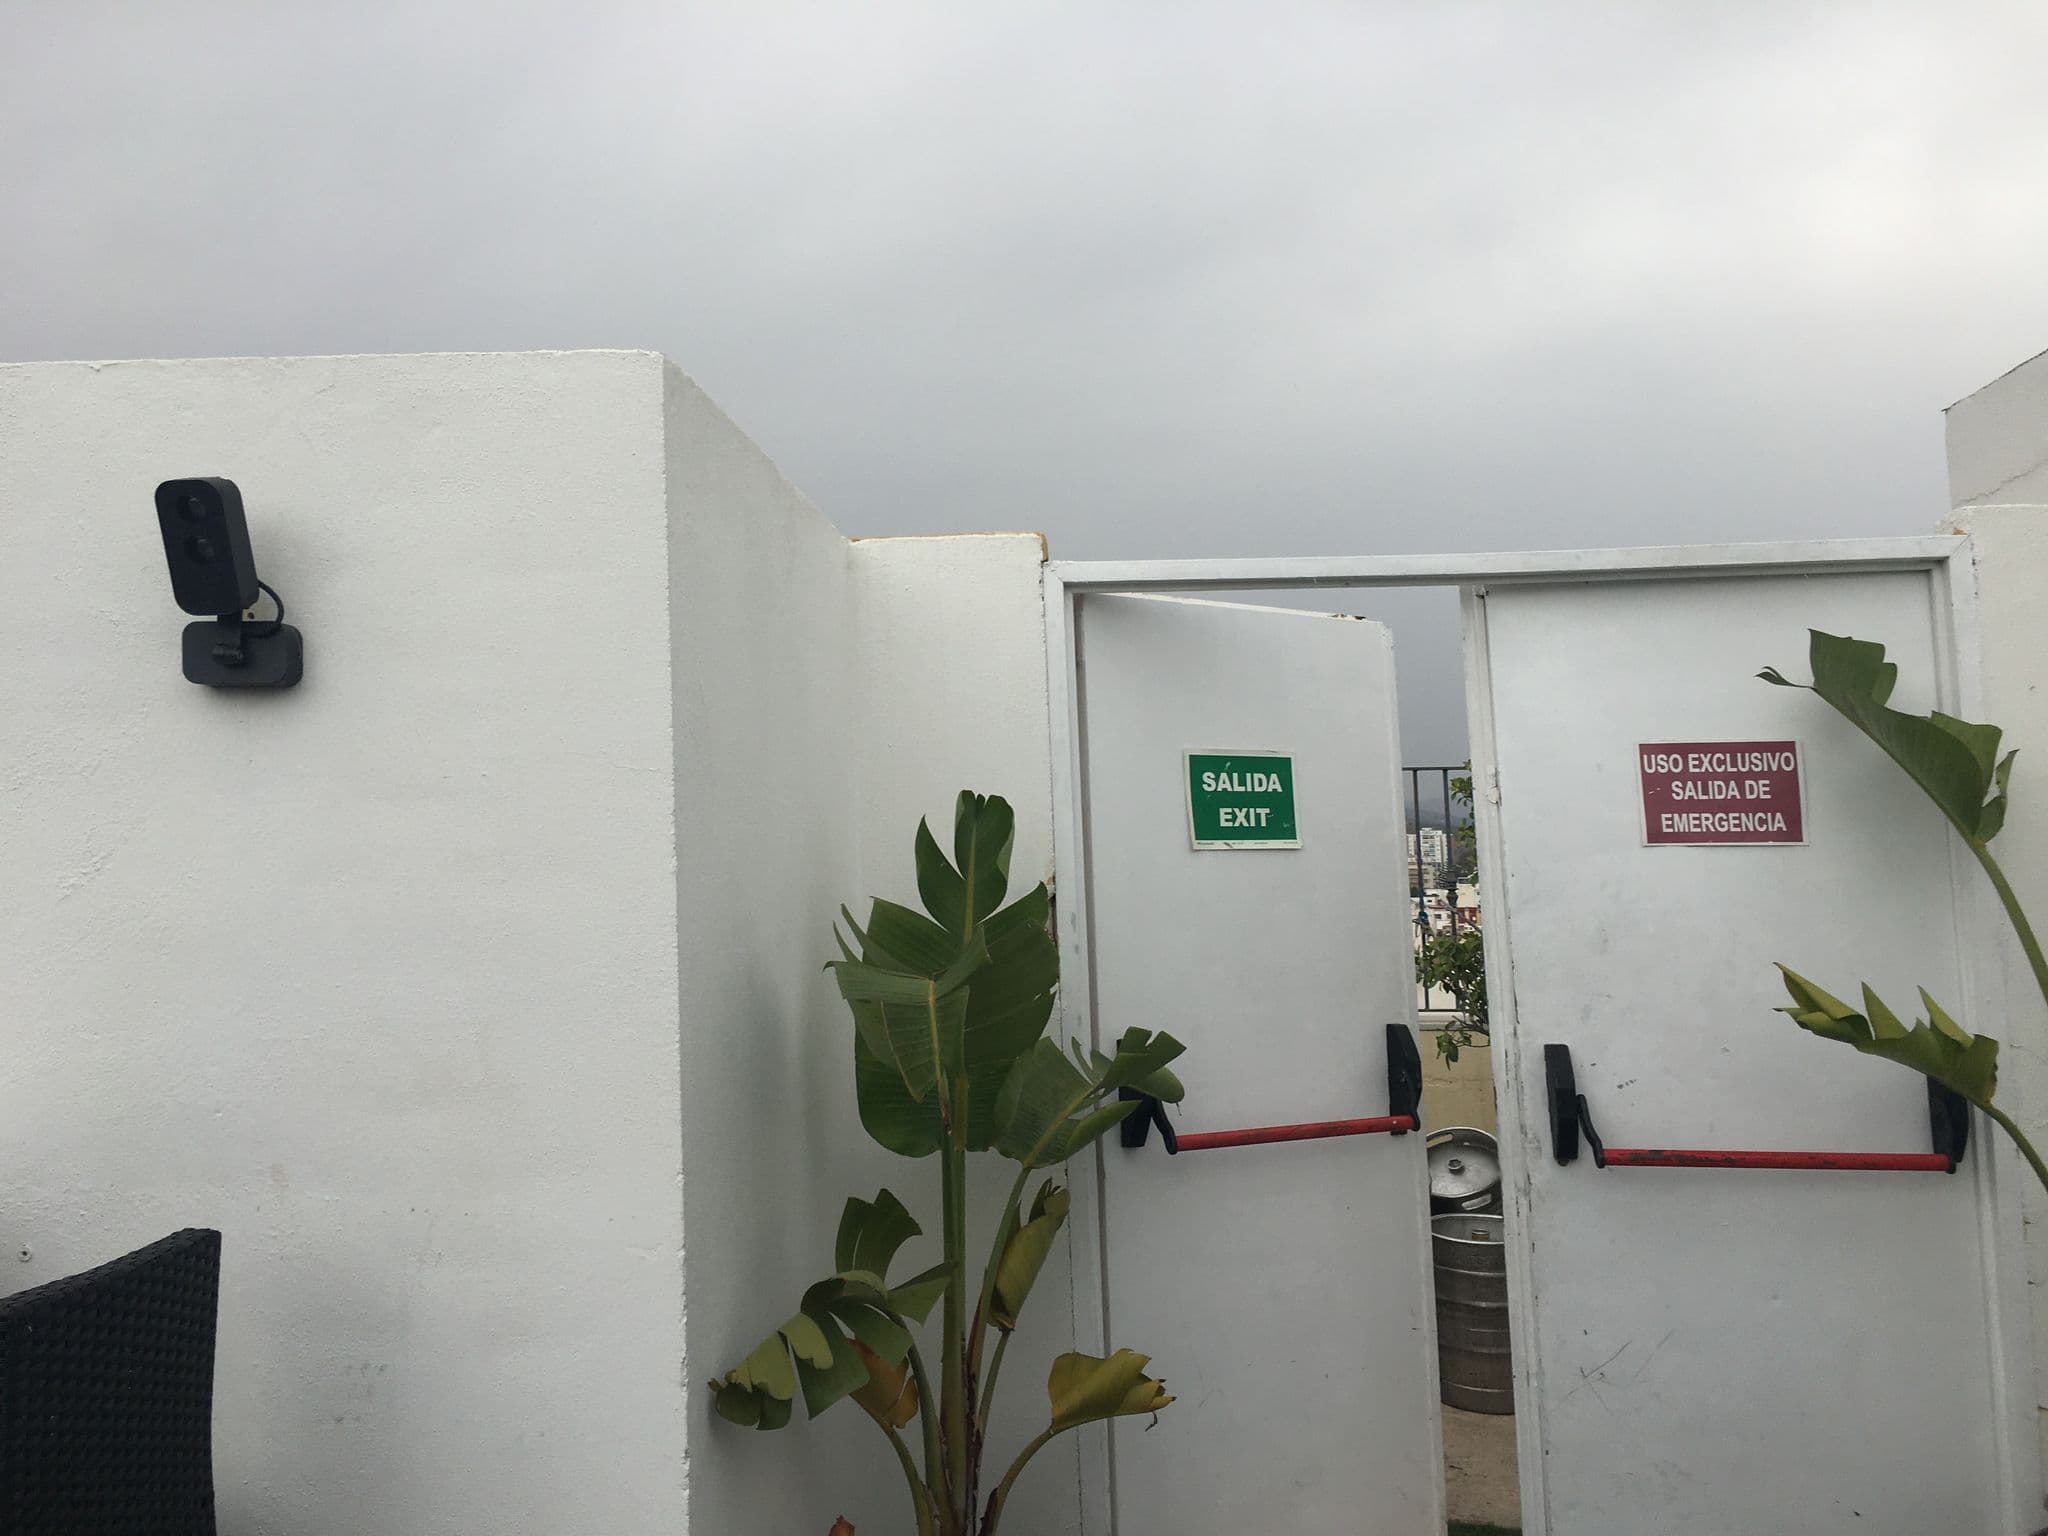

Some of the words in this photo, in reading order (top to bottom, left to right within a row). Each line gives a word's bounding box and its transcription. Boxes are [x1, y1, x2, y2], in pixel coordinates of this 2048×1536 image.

[1643, 753, 1683, 773] USO
[1688, 752, 1796, 773] EXCLUSIVO
[1671, 780, 1742, 800] SALIDA
[1745, 780, 1772, 800] DE
[1219, 807, 1270, 827] EXIT
[1661, 812, 1787, 832] EMERGENCIA
